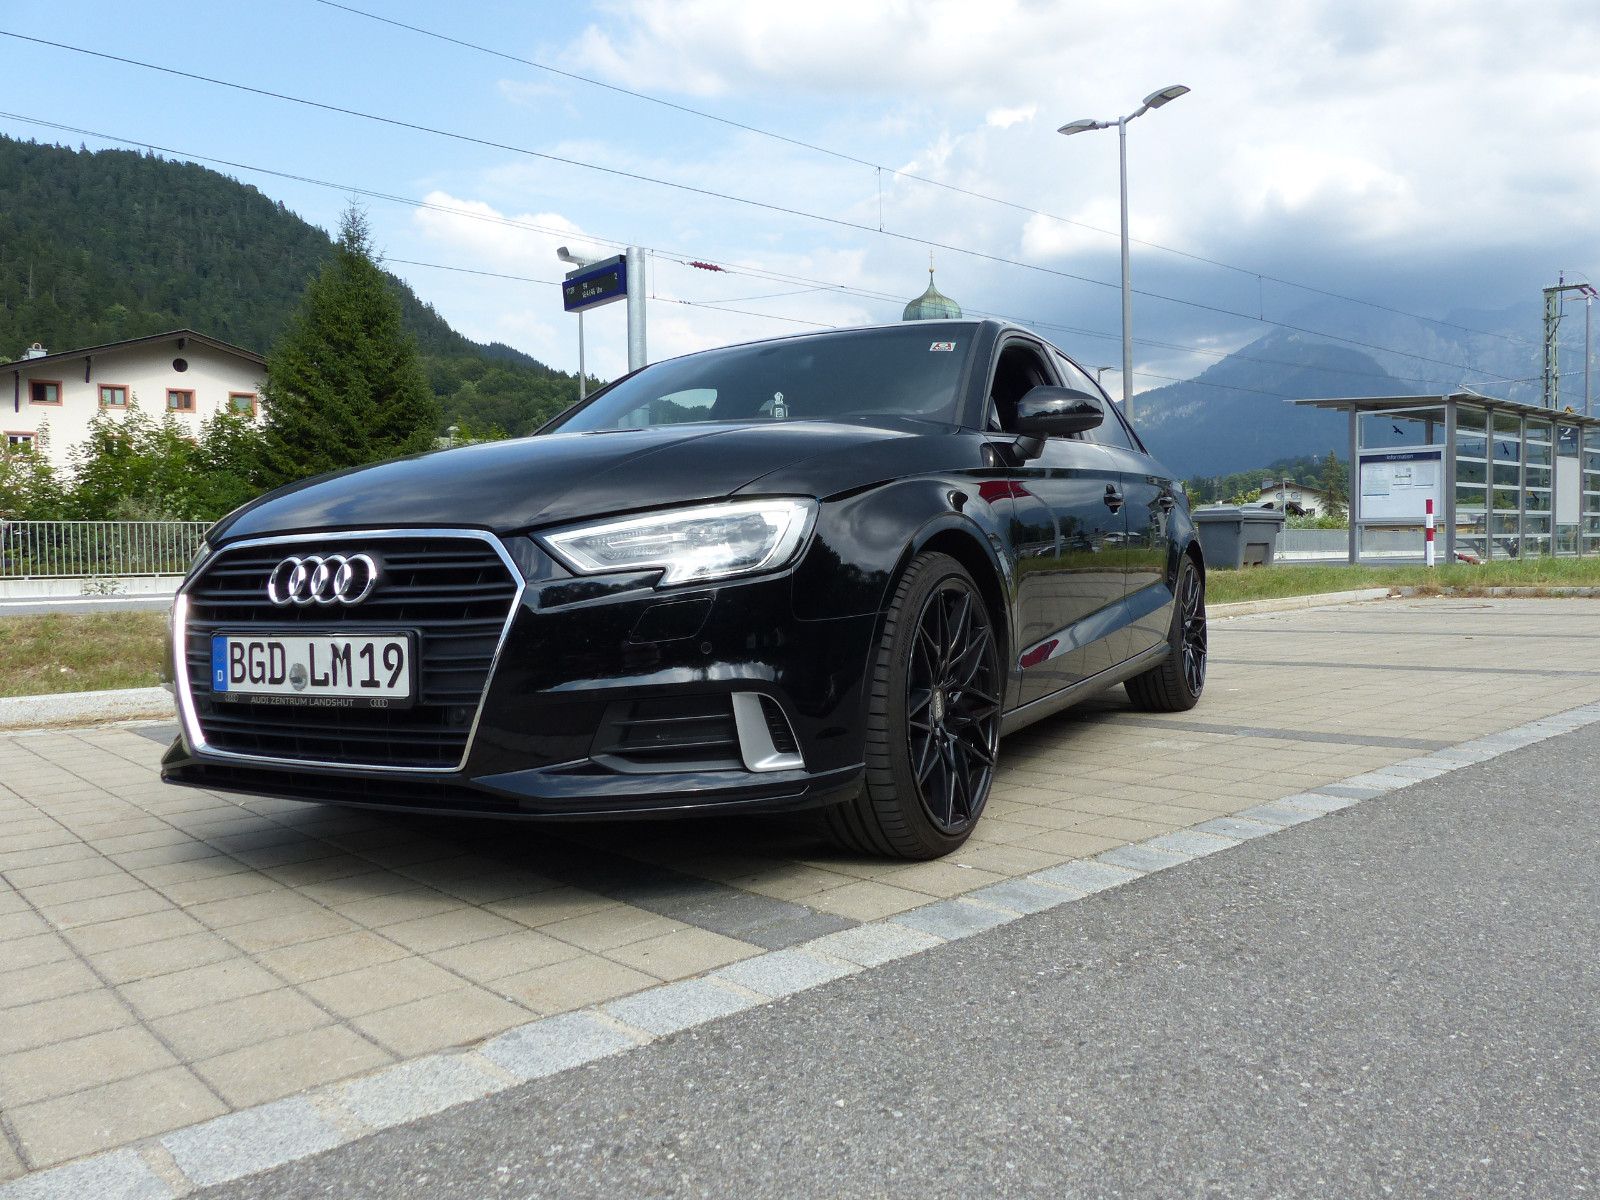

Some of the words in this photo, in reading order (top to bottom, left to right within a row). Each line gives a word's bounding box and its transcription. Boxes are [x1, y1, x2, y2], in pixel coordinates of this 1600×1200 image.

[1560, 426, 1571, 440] 2
[1386, 453, 1414, 461] Information
[229, 641, 287, 685] BGD
[217, 670, 223, 682] D
[250, 696, 269, 704] AUDI
[270, 696, 307, 705] ZENTRUM
[309, 697, 354, 707] LANDSHUT
